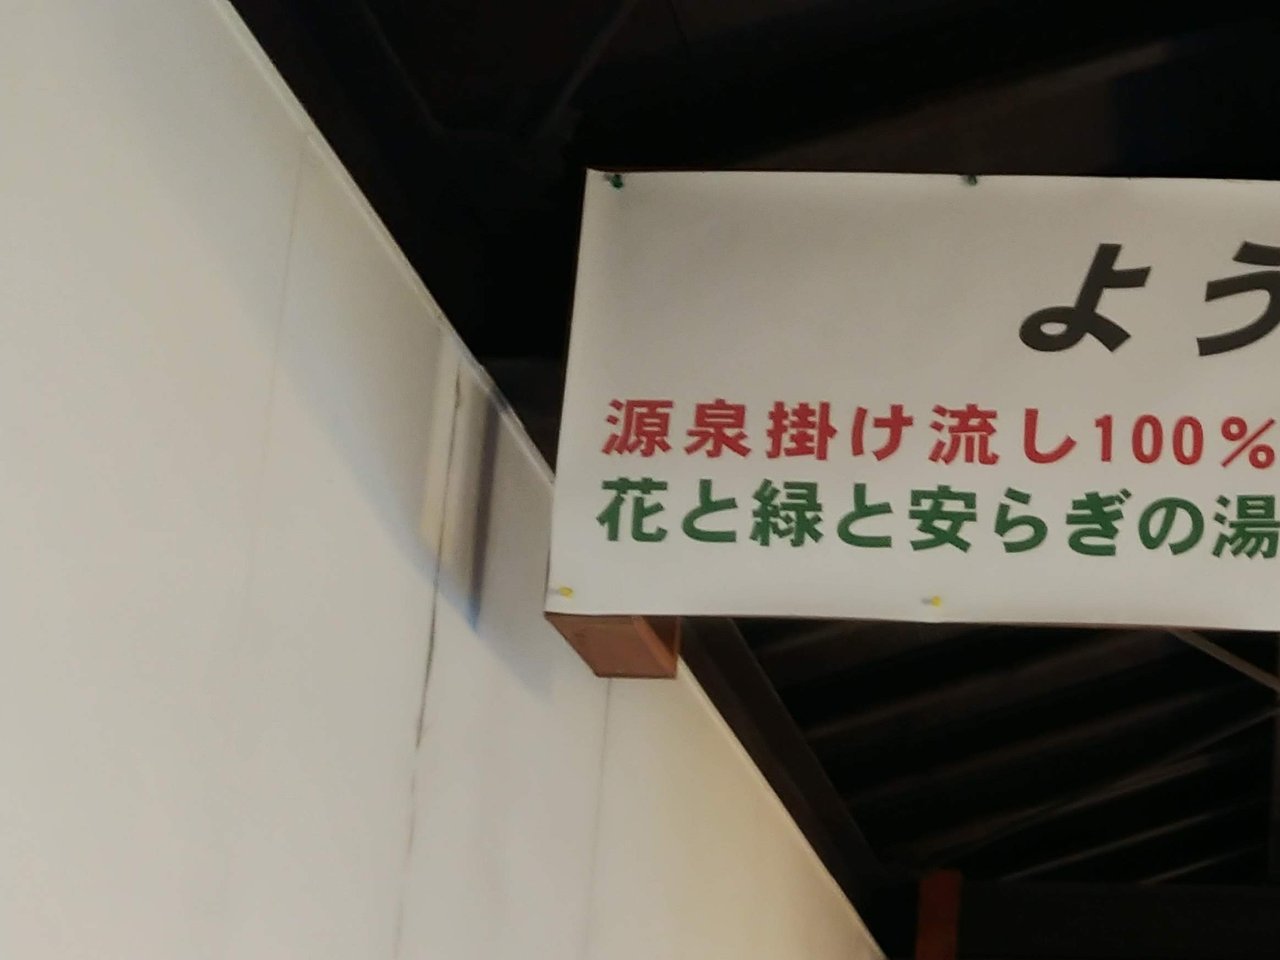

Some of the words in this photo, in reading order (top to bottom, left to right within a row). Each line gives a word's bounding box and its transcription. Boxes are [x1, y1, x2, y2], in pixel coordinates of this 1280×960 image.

[601, 398, 1277, 470] 源泉掛け流し100%
